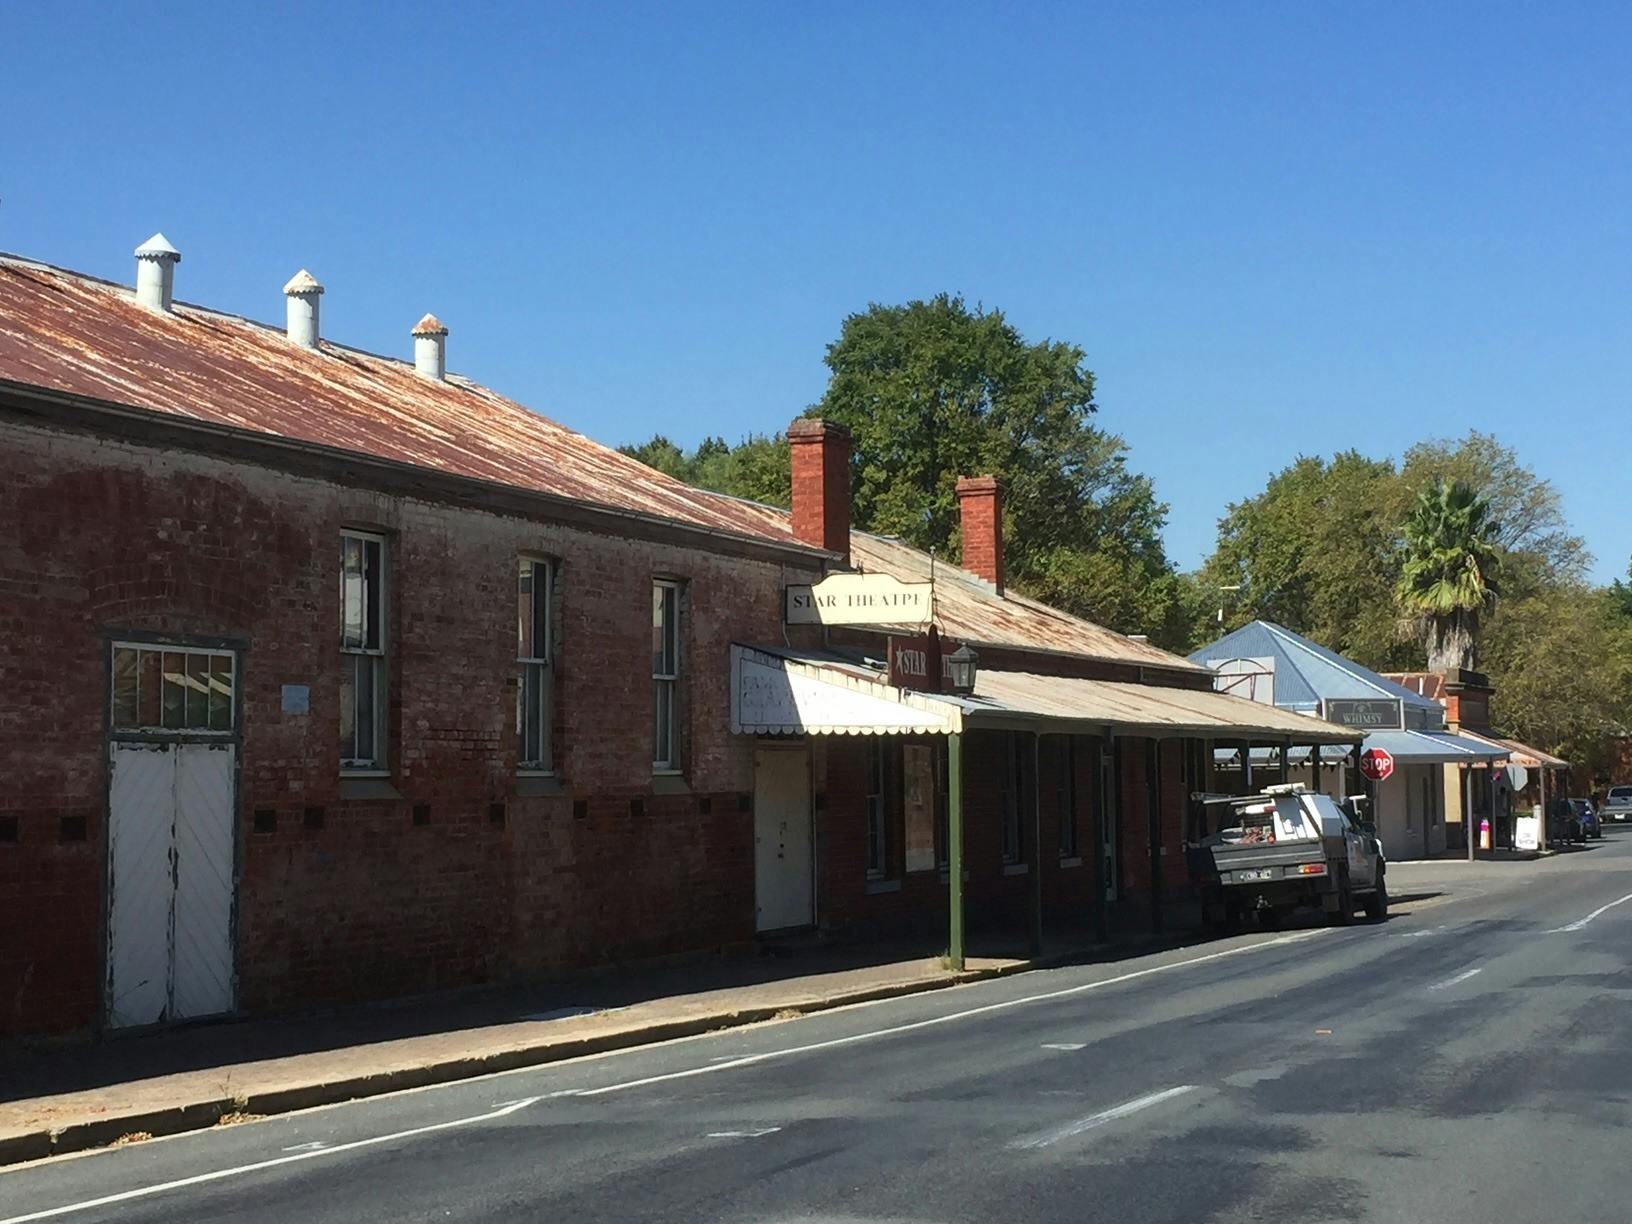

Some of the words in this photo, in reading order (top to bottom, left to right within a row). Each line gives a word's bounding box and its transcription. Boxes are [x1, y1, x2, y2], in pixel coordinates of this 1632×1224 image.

[793, 594, 836, 608] STAR
[903, 649, 927, 676] STAR
[1343, 712, 1382, 724] WHIMSY
[1362, 758, 1390, 771] STOP
